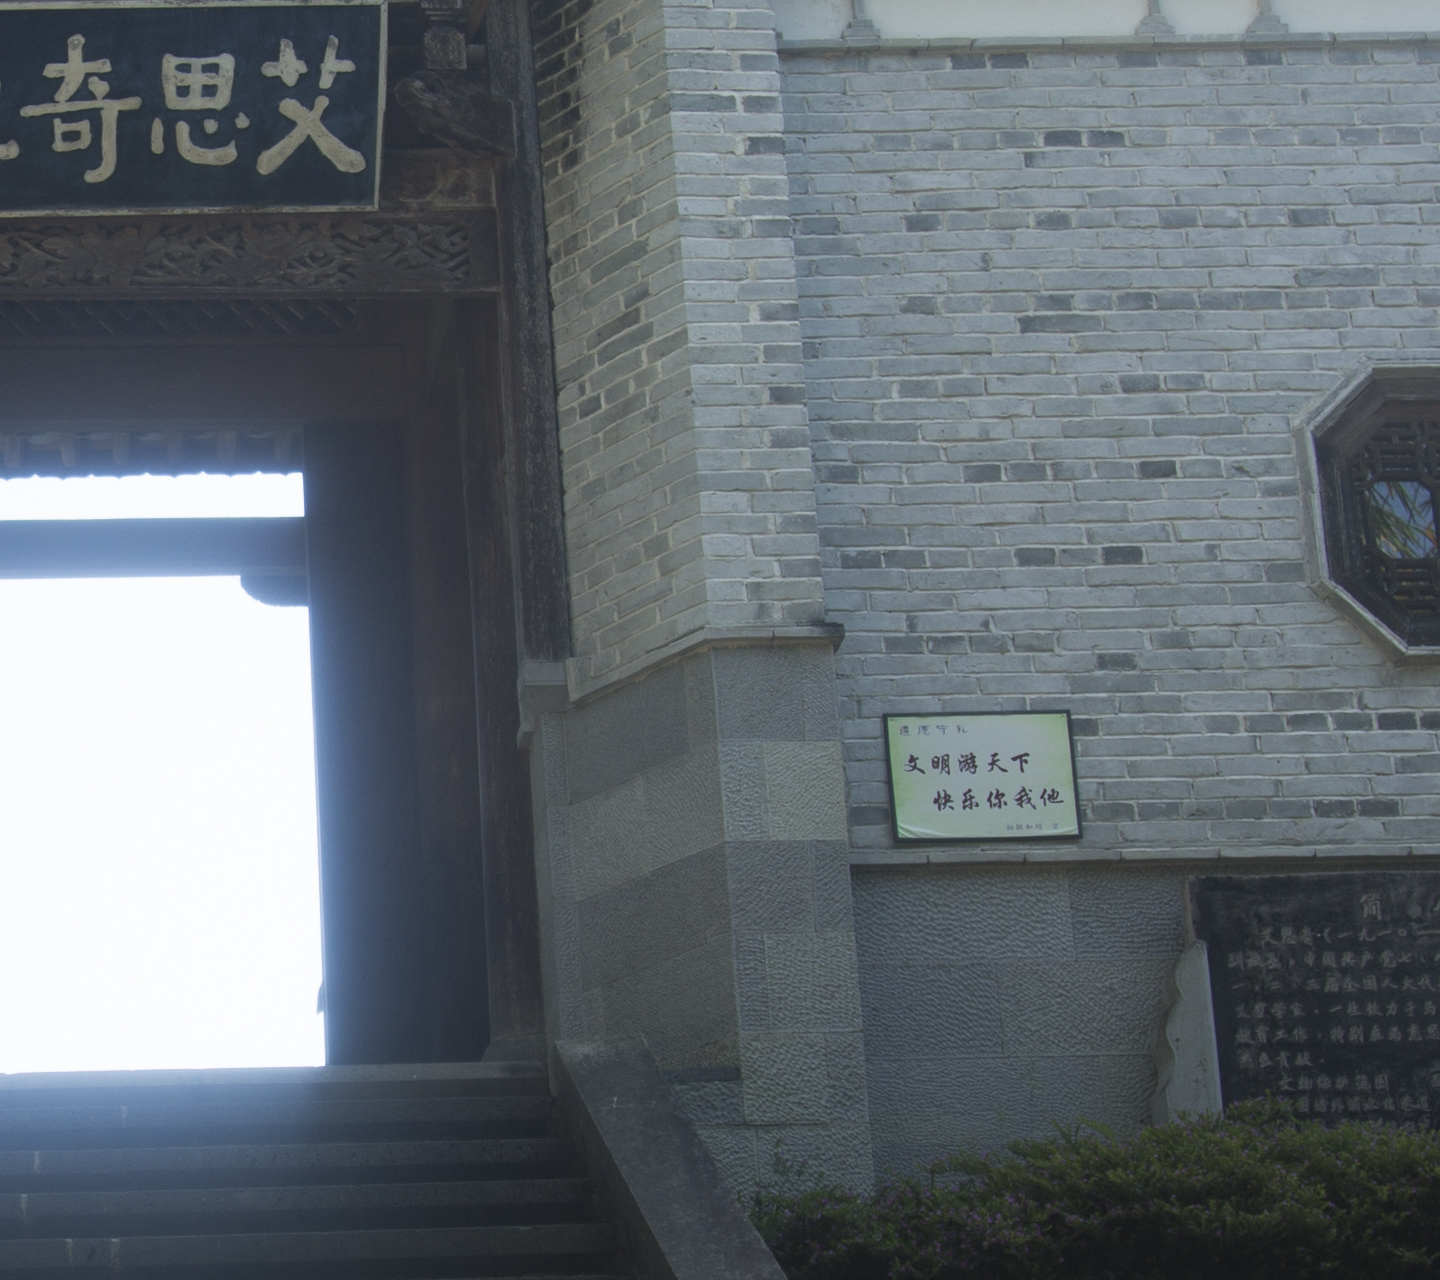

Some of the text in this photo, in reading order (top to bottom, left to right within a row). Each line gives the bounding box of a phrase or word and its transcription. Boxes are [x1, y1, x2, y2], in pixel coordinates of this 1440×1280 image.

[904, 751, 1031, 776] 文明游天下
[932, 785, 1065, 812] 快乐你我他
